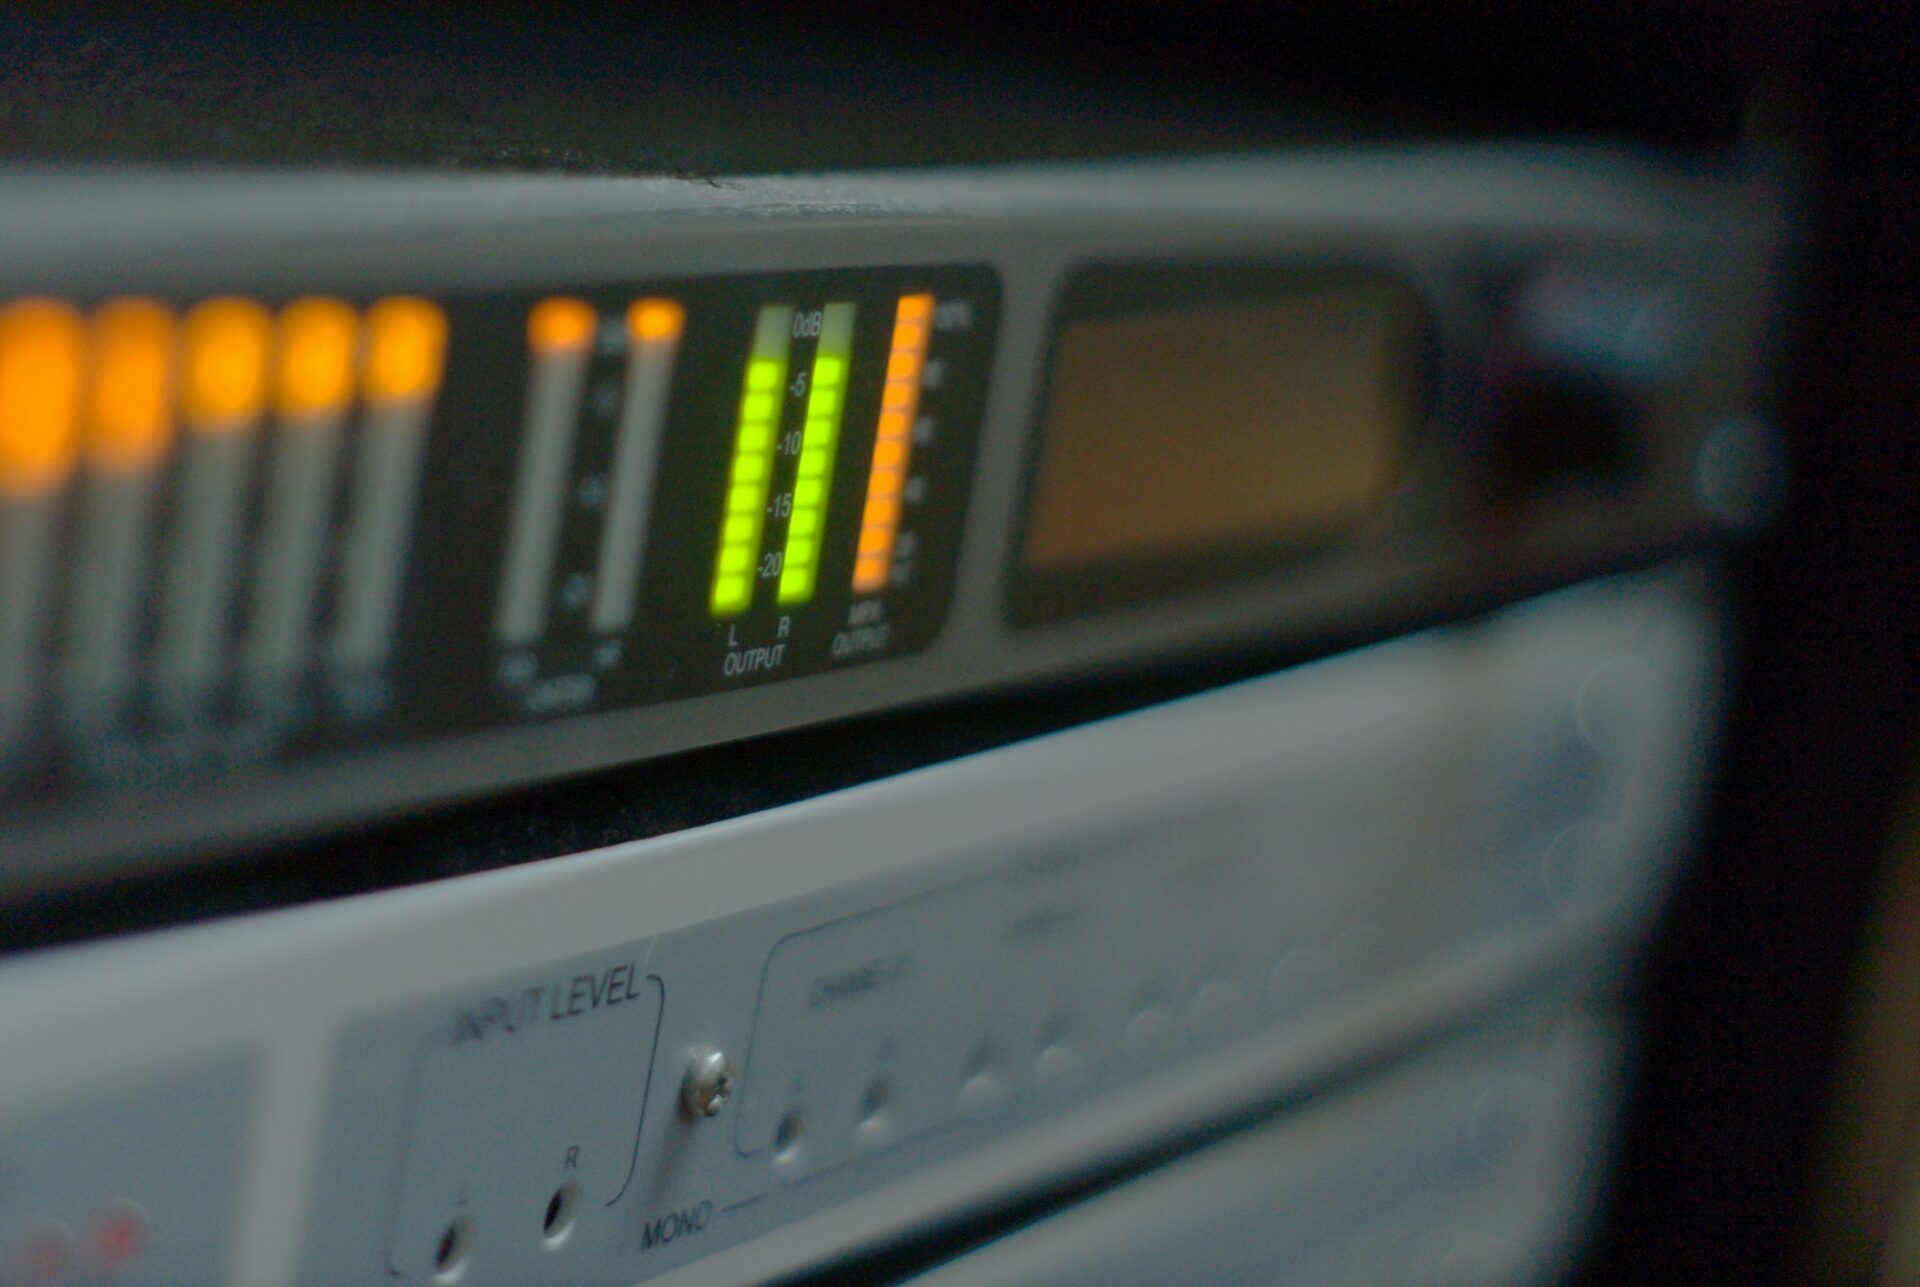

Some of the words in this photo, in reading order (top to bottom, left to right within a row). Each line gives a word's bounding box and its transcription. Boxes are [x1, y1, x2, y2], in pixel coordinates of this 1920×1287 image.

[793, 311, 822, 338] 0dB
[790, 372, 807, 397] -5
[776, 430, 801, 456] -10
[767, 493, 792, 518] -15
[757, 551, 782, 578] -20
[728, 625, 738, 648] L
[777, 615, 791, 638] R
[723, 644, 786, 678] OUTPUT
[550, 963, 640, 1021] LEVEL
[564, 1144, 579, 1171] R
[641, 1199, 712, 1251] MONO
